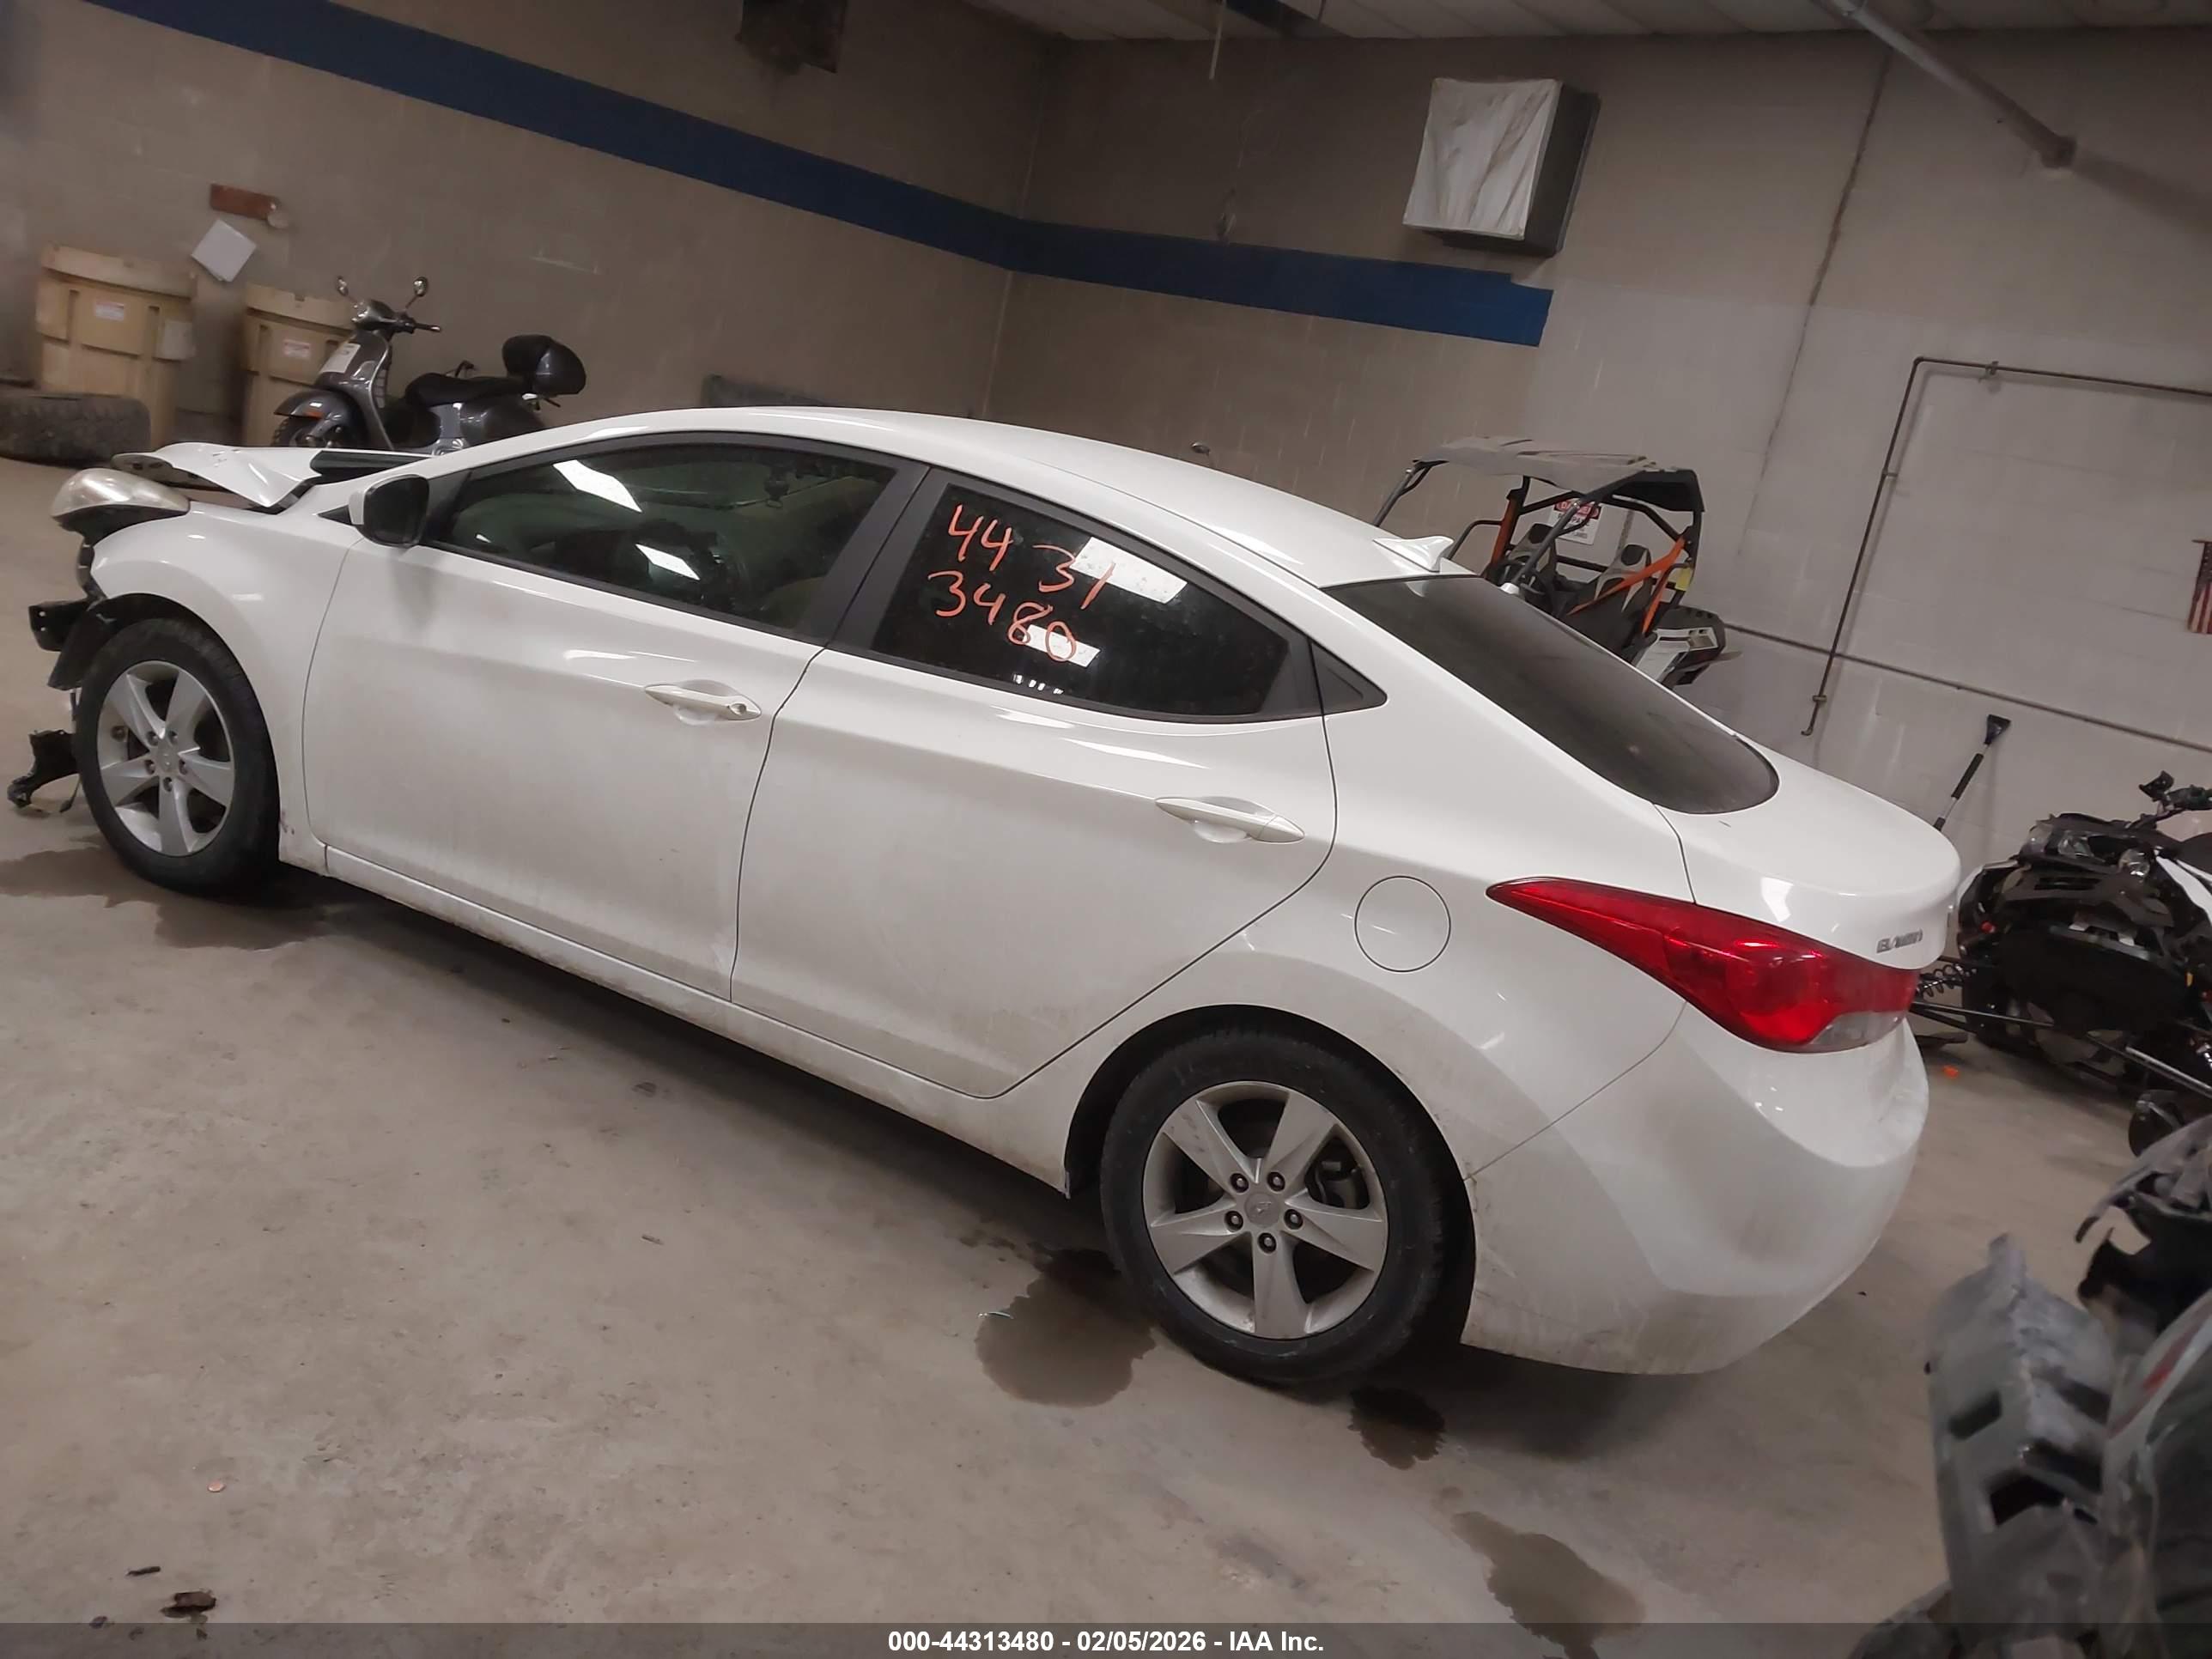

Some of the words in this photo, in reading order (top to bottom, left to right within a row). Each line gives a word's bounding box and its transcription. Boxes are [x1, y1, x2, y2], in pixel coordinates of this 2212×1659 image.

[947, 503, 1014, 572] 44
[1032, 544, 1116, 610] 31
[927, 569, 1077, 662] 3480
